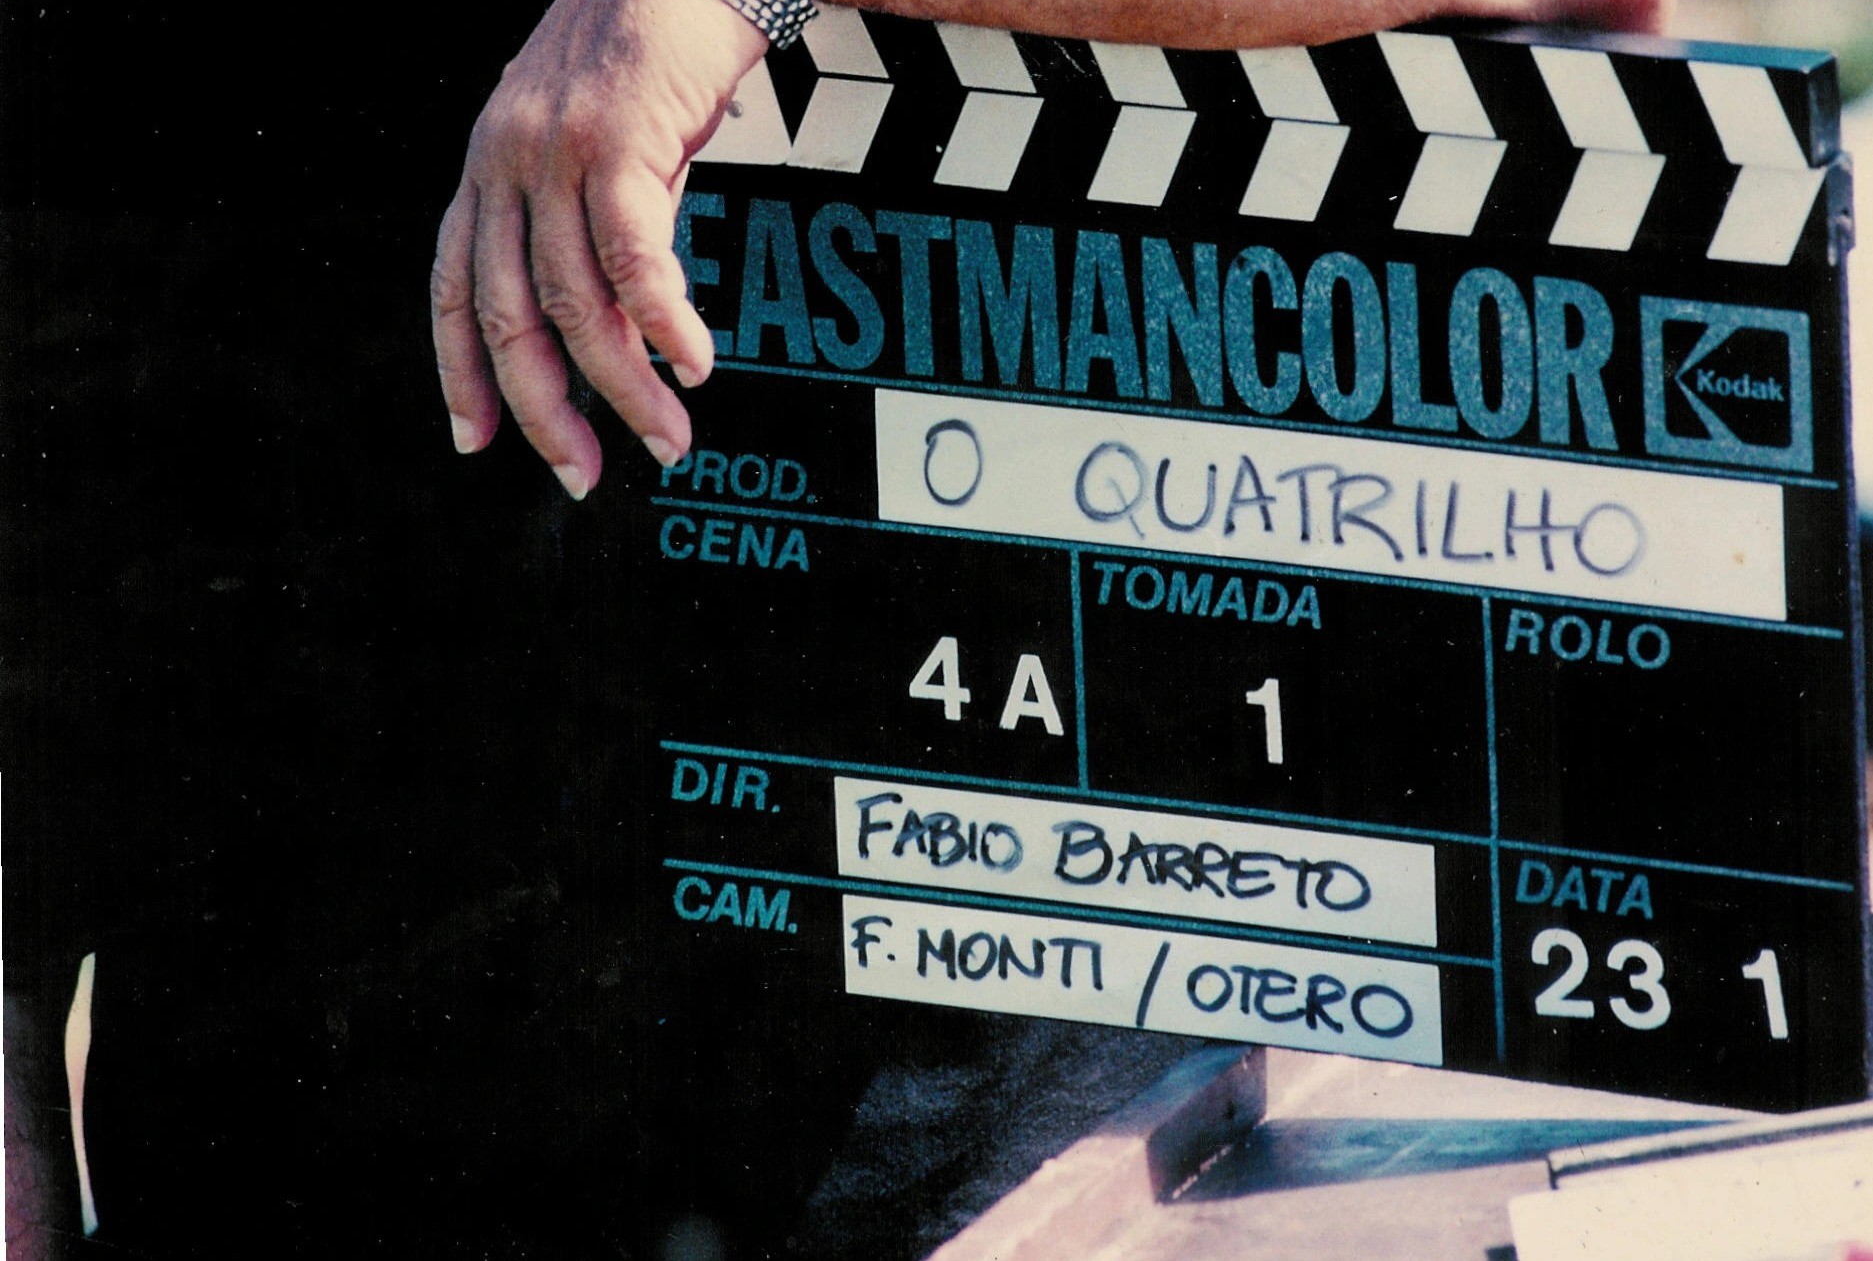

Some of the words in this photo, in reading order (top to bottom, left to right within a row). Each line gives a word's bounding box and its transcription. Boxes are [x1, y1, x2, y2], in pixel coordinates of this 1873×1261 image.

[674, 192, 1618, 449] EASTMANCOLOR
[1697, 368, 1785, 402] Kodak
[661, 450, 816, 504] PROD.
[924, 419, 983, 507] O
[1074, 441, 1647, 576] QUATRILHO
[659, 514, 810, 572] CENA
[1093, 560, 1322, 630] TOMADA
[1505, 607, 1671, 670] ROLO
[1246, 678, 1283, 764] 1
[671, 758, 780, 813] DIR.
[855, 791, 1024, 873] FABIO
[1053, 820, 1372, 912] BARRETO
[672, 876, 798, 934] CAM.
[1514, 859, 1654, 920] DATA
[850, 915, 897, 968] F.
[916, 927, 1104, 991] MONTI
[1186, 958, 1414, 1039] OTERO
[1531, 928, 1671, 1030] 23
[1742, 949, 1789, 1040] 1
